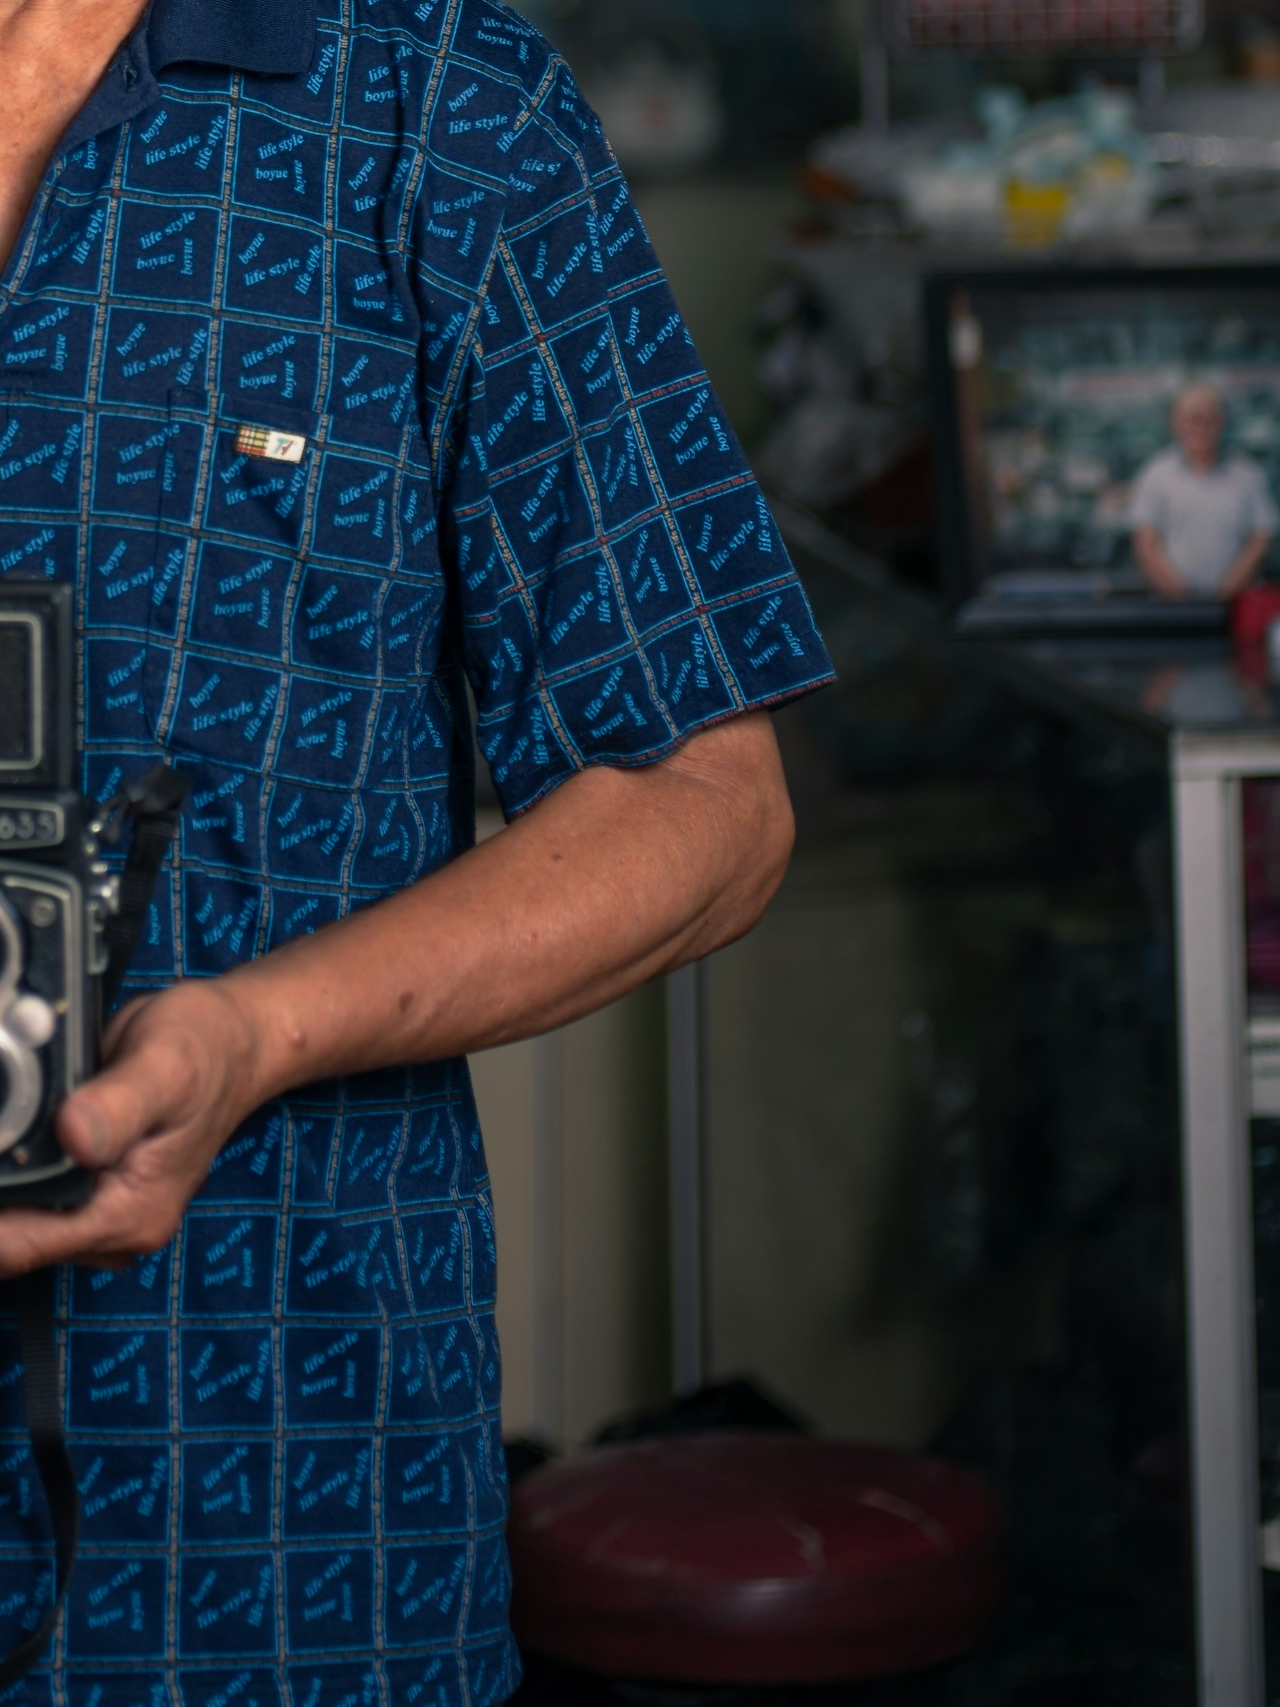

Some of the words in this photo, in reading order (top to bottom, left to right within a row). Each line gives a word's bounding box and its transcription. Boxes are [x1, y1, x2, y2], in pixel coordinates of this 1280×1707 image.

[414, 3, 433, 22] life
[304, 74, 323, 96] life
[318, 43, 336, 75] style
[448, 82, 479, 112] boyue
[140, 110, 168, 143] boyue
[448, 120, 472, 134] life
[474, 114, 508, 130] style
[144, 149, 166, 166] life
[168, 135, 200, 156] style
[194, 147, 212, 170] life
[208, 114, 225, 146] style
[258, 143, 278, 160] life
[278, 134, 304, 150] style
[254, 167, 288, 180] boyue
[348, 156, 376, 190] boyue
[72, 241, 90, 265] life
[86, 207, 105, 241] style
[139, 230, 162, 249] life
[164, 212, 196, 235] style
[426, 220, 457, 238] boyue
[458, 218, 476, 257] boyue
[134, 254, 175, 270] boyue
[180, 238, 194, 276] boyue
[238, 232, 266, 264] boyue
[244, 270, 266, 286] life
[268, 258, 300, 276] style
[294, 274, 312, 294] life
[306, 244, 322, 274] style
[546, 273, 566, 298] life
[564, 242, 586, 274] style
[352, 297, 386, 310] boyue
[12, 324, 36, 342] life
[38, 306, 70, 328] style
[116, 322, 146, 356] boyue
[4, 348, 46, 364] boyue
[50, 334, 68, 372] boyue
[122, 360, 146, 378] life
[148, 347, 181, 366] style
[176, 362, 194, 385] life
[189, 328, 207, 361] style
[241, 351, 264, 368] life
[266, 336, 296, 355] style
[239, 374, 276, 388] boyue
[280, 360, 296, 399] boyue
[340, 354, 368, 386] boyue
[528, 362, 546, 396] style
[486, 422, 504, 446] life
[504, 392, 528, 422] style
[532, 400, 546, 422] life
[668, 421, 688, 443] life
[686, 388, 709, 420] style
[674, 436, 708, 465] boyue
[708, 416, 730, 452] boyue
[0, 460, 22, 480] life
[24, 444, 56, 466] style
[51, 460, 68, 484] life
[63, 423, 81, 457] style
[340, 487, 361, 506] life
[363, 470, 388, 492] style
[520, 498, 540, 522] life
[538, 464, 558, 498] style
[332, 513, 370, 528] boyue
[372, 498, 385, 538] boyue
[754, 492, 774, 526] style
[696, 514, 713, 552] boyue
[710, 550, 730, 572] life
[728, 520, 754, 550] style
[758, 529, 772, 553] life
[597, 562, 608, 599] style
[256, 588, 270, 628] boyue
[306, 584, 338, 618] boyue
[550, 621, 570, 645] life
[568, 591, 594, 622] style
[598, 600, 611, 623] life
[308, 624, 332, 640] life
[336, 610, 368, 630] style
[742, 628, 760, 649] life
[758, 596, 782, 626] style
[748, 643, 780, 668] boyue
[780, 622, 805, 658] boyue
[189, 673, 220, 708] boyue
[584, 698, 604, 720] life
[601, 666, 623, 698] style
[192, 714, 216, 730] life
[218, 700, 252, 721] style
[591, 713, 624, 738] boyue
